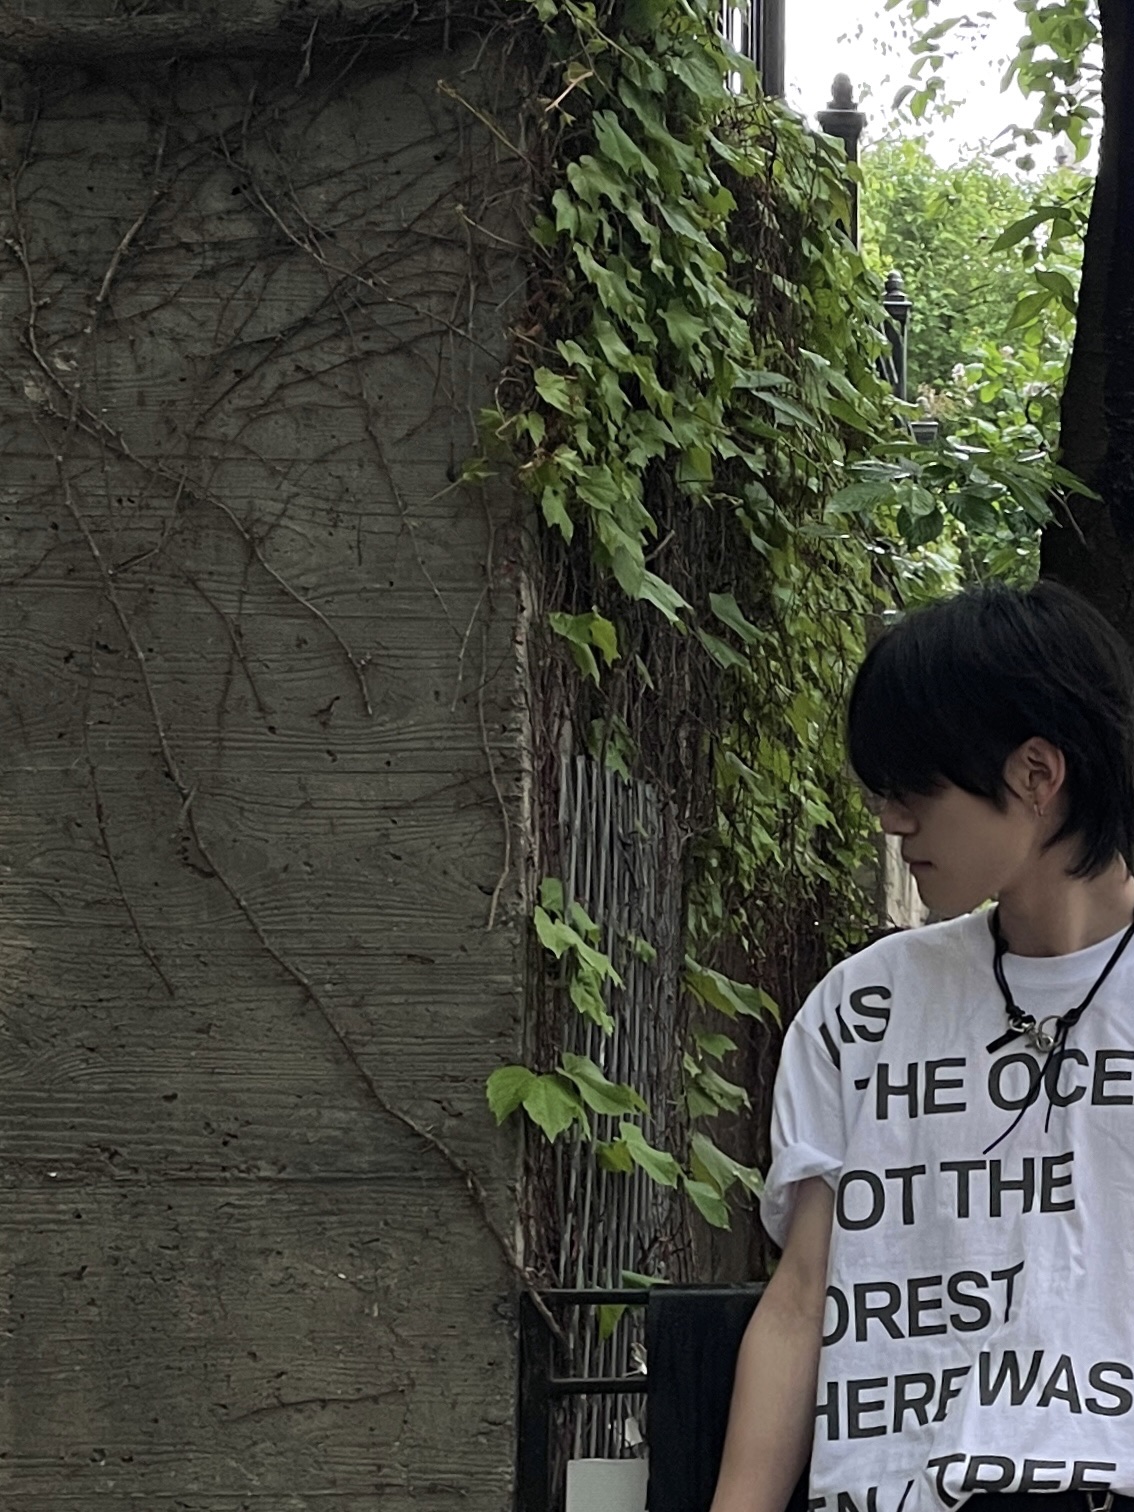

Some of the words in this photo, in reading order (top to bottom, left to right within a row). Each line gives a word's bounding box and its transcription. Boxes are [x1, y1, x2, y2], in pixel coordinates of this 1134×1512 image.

[854, 1057, 967, 1121] HE
[836, 1164, 926, 1231] OT
[940, 1152, 1075, 1218] THE
[821, 1261, 1025, 1347] OREST
[815, 1365, 972, 1441] HERE
[978, 1350, 1134, 1416] WAS
